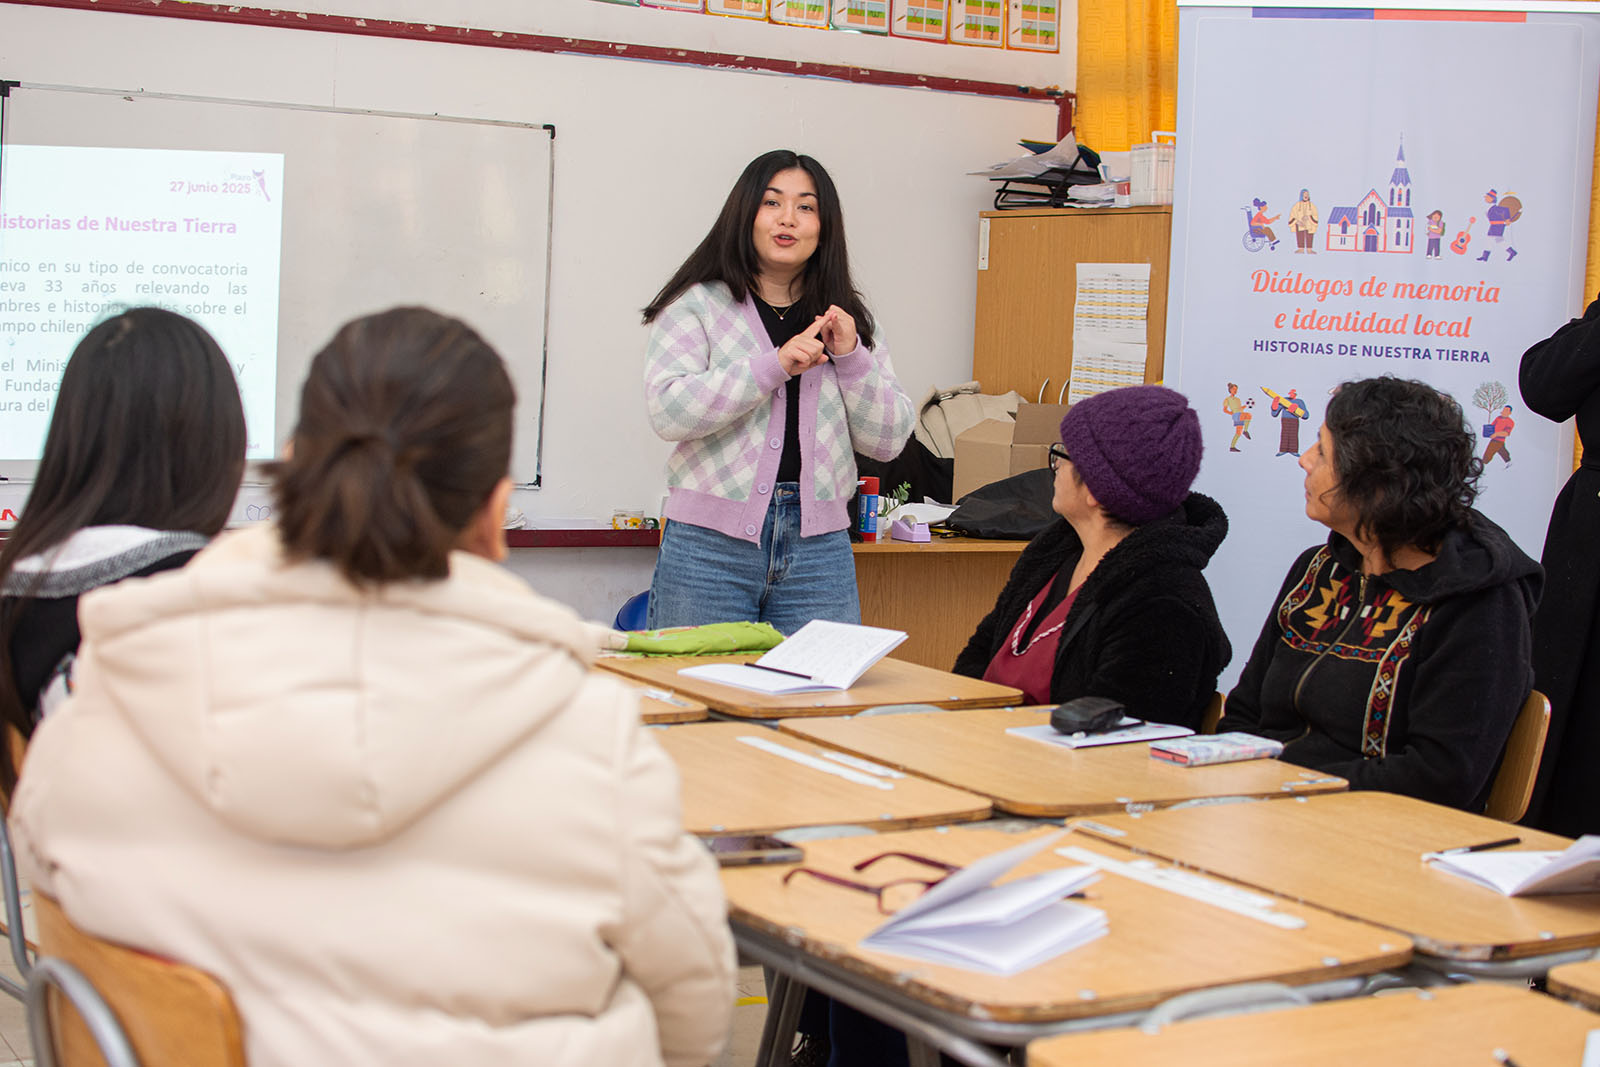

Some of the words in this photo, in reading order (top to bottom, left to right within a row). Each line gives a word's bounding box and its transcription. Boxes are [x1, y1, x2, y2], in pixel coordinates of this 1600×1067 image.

[169, 181, 185, 193] 27
[186, 181, 218, 195] junio
[222, 182, 251, 194] 2025
[0, 213, 71, 231] istorias
[77, 215, 100, 231] de
[105, 217, 177, 233] Nuestra
[183, 218, 237, 234] Tierra
[38, 263, 57, 273] en
[64, 263, 81, 273] su
[89, 261, 118, 276] tipo
[126, 261, 144, 274] de
[152, 262, 248, 276] convocatoria
[45, 280, 63, 292] 33
[81, 280, 117, 293] años
[135, 281, 210, 295] relevando
[228, 282, 248, 295] las
[1251, 269, 1353, 301] Diálogos
[1359, 276, 1388, 298] de
[1392, 280, 1501, 303] memoria
[47, 303, 57, 313] e
[185, 302, 227, 315] sobre
[234, 302, 247, 315] el
[1274, 312, 1287, 329] e
[1293, 308, 1409, 335] identidad
[1413, 314, 1473, 338] local
[1253, 340, 1334, 355] HISTORIAS
[1338, 344, 1358, 357] DE
[1362, 345, 1432, 360] NUESTRA
[1436, 349, 1491, 364] TIERRA
[1, 358, 14, 371] el
[236, 363, 245, 376] y
[27, 398, 50, 412] del
